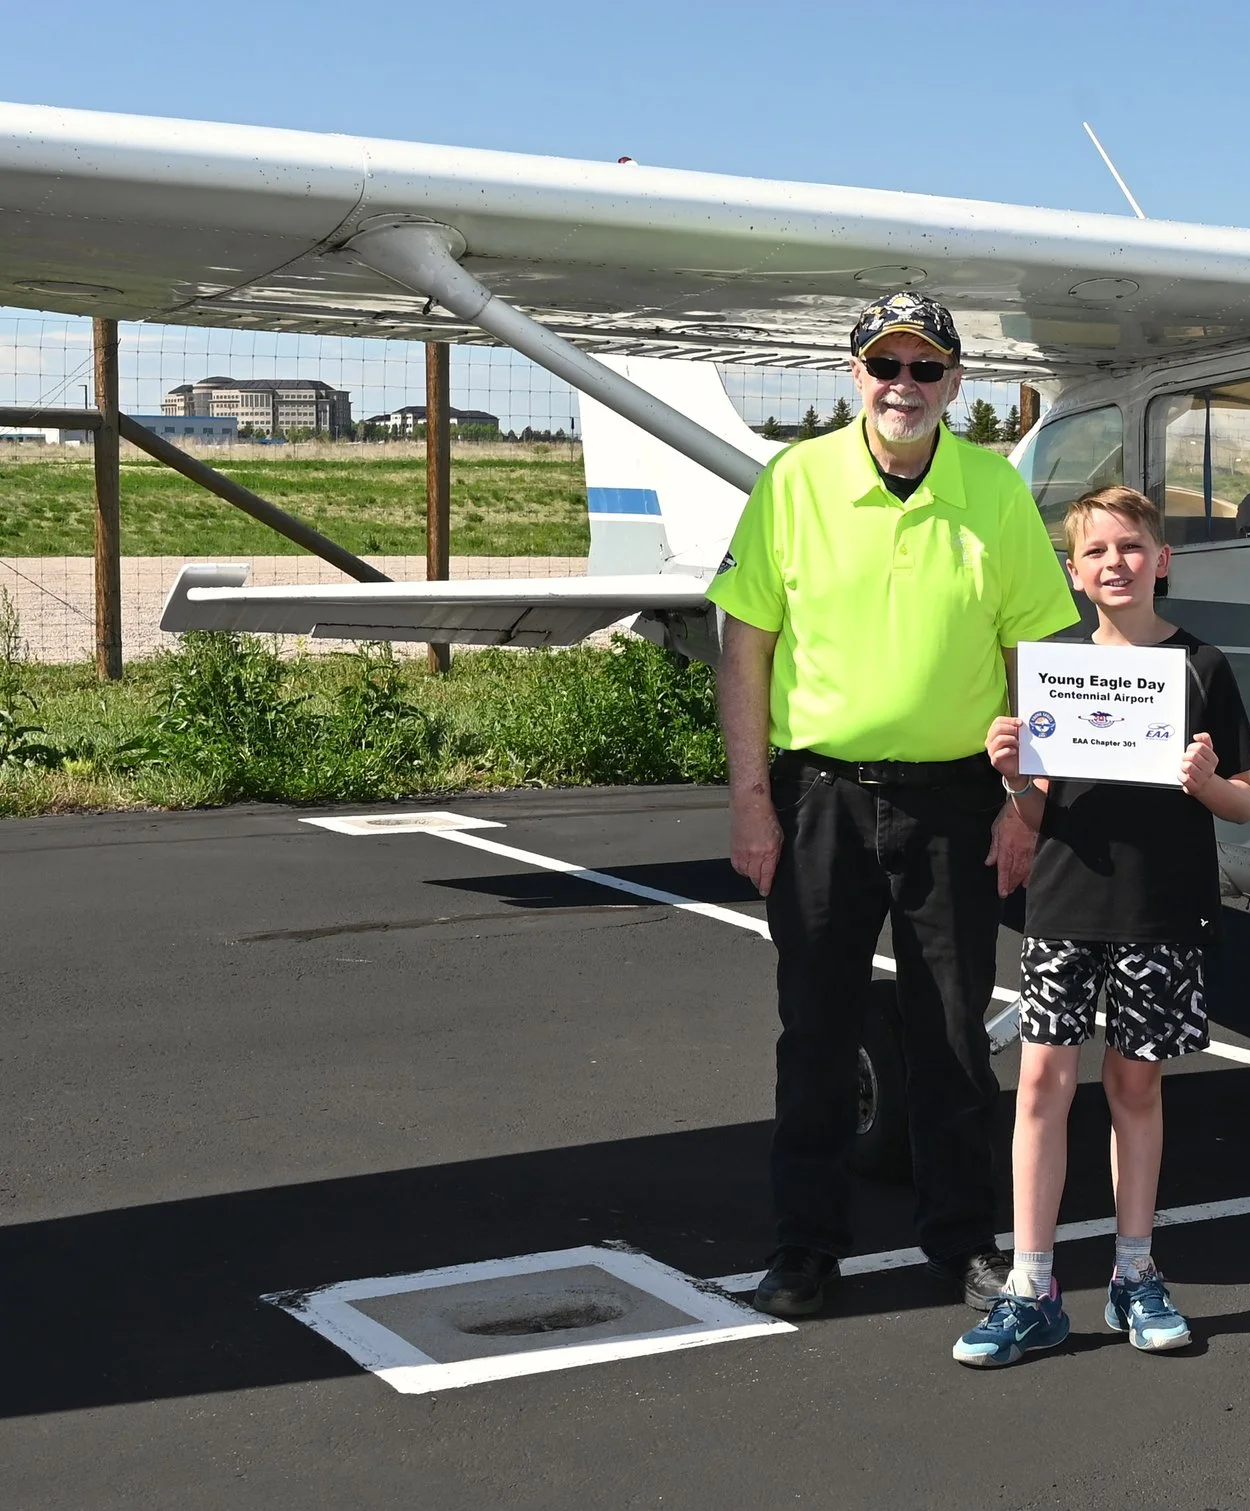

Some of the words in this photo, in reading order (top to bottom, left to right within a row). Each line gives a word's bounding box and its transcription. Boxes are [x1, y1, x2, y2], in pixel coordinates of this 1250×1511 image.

[1038, 672, 1085, 688] Young
[1090, 675, 1132, 690] Eagle
[1137, 678, 1166, 693] Day
[1049, 689, 1110, 701] Centennial
[1114, 693, 1154, 704] Airport
[1146, 730, 1169, 738] EAA
[1072, 737, 1089, 745] EAA
[1090, 739, 1121, 748] Chapter
[1122, 740, 1136, 748] 301
